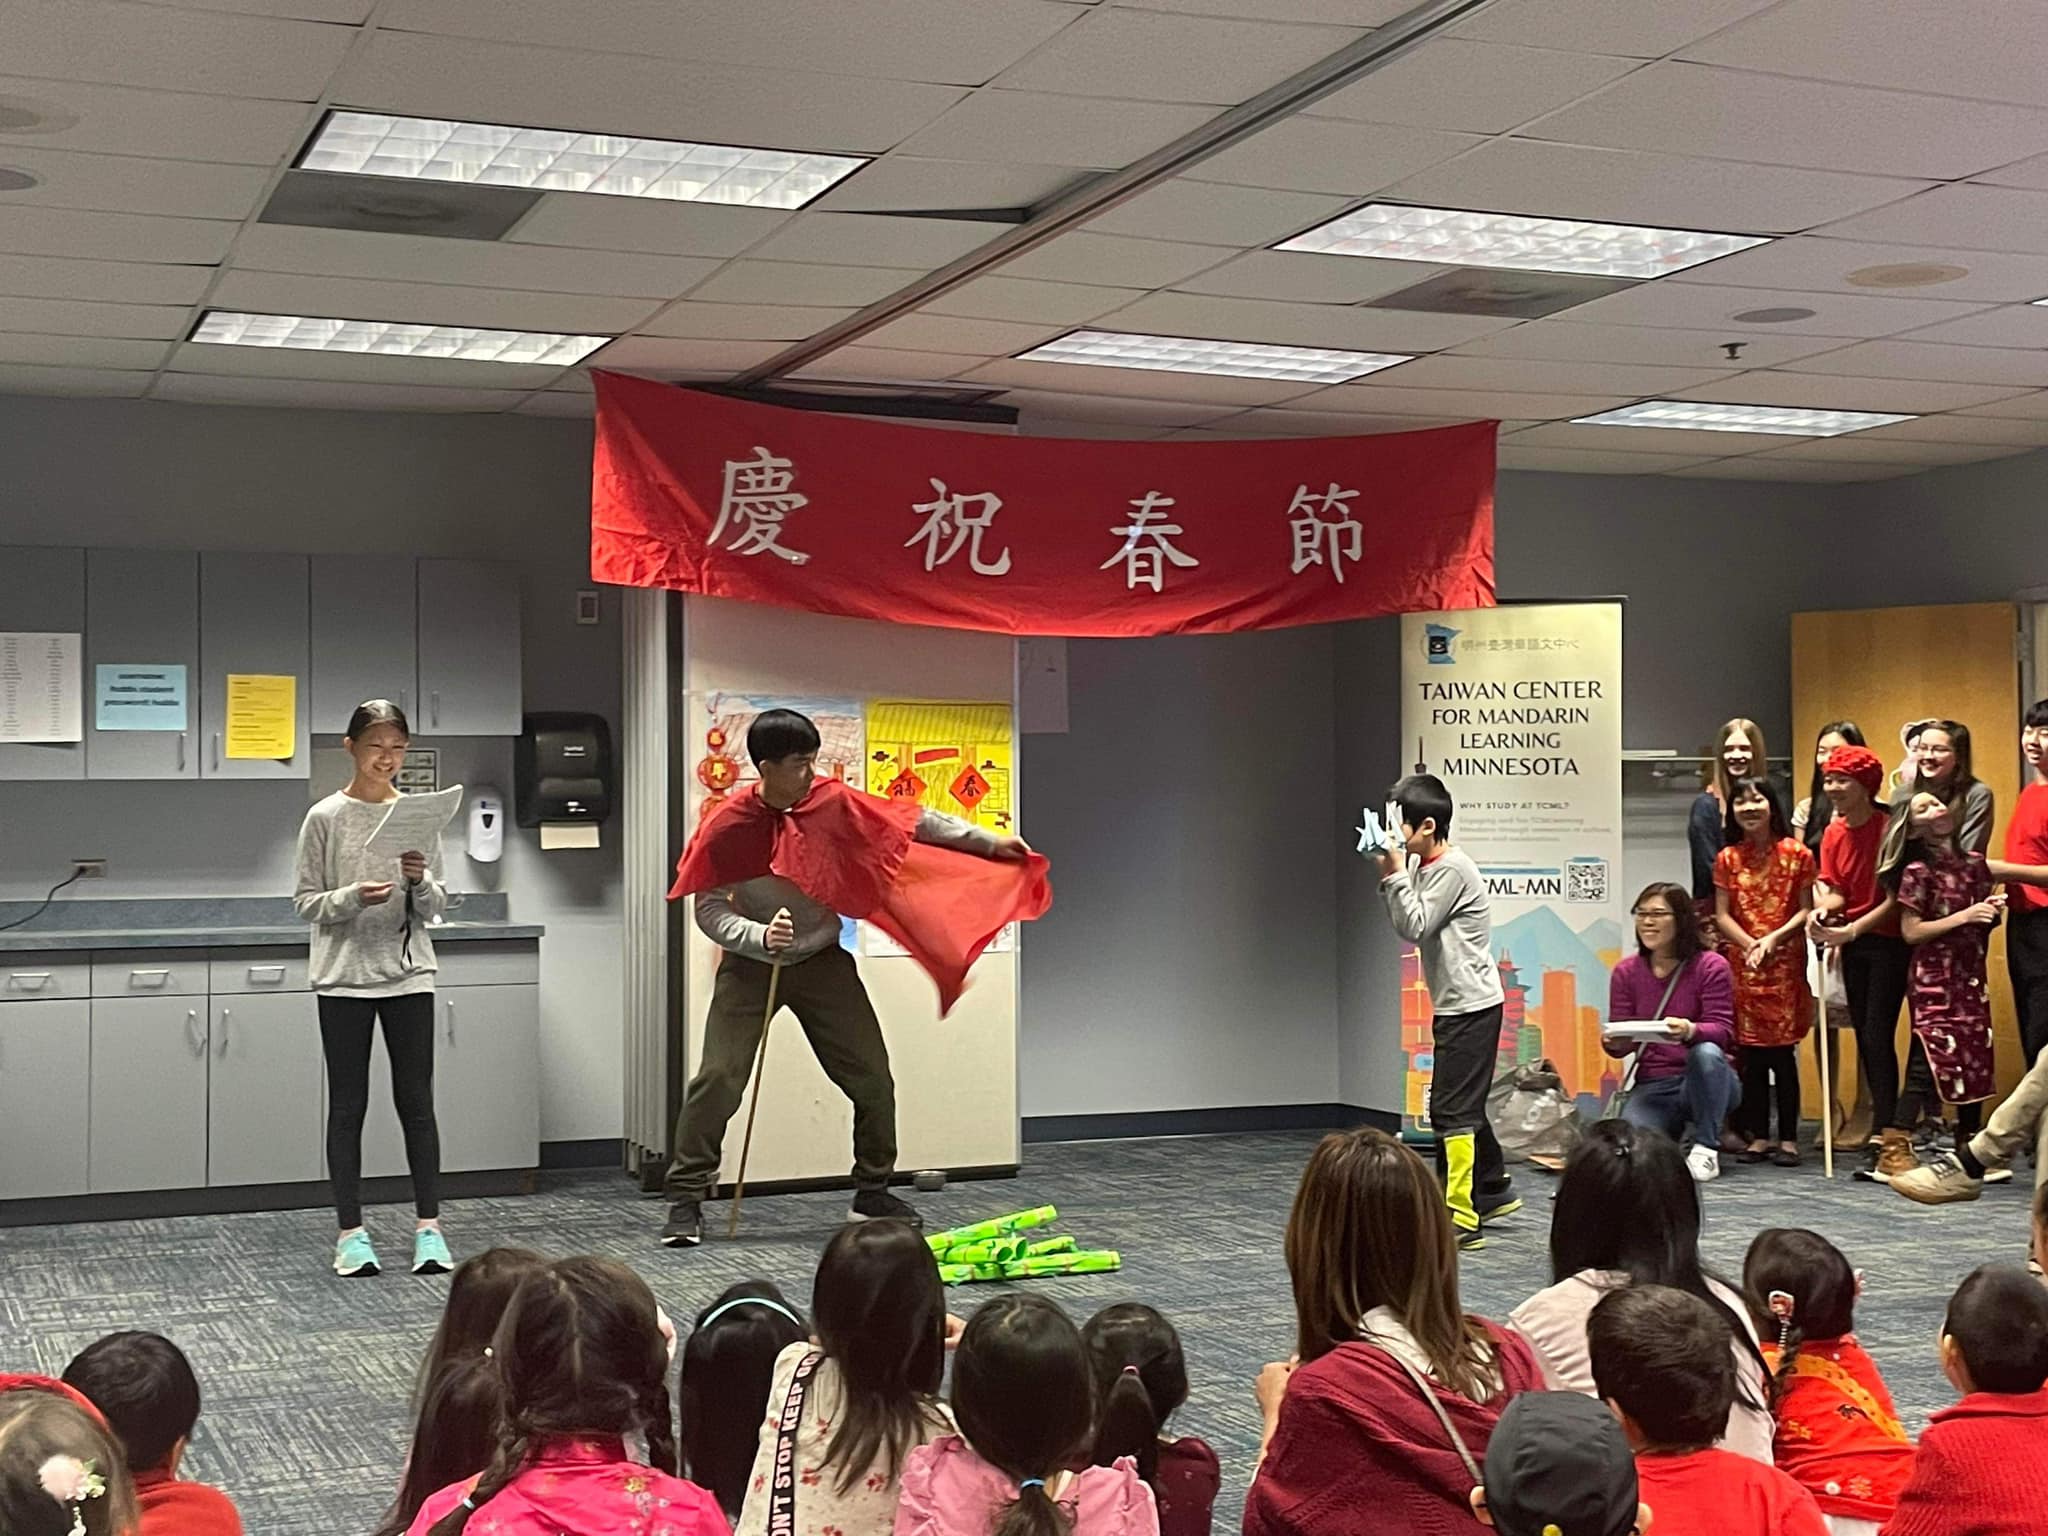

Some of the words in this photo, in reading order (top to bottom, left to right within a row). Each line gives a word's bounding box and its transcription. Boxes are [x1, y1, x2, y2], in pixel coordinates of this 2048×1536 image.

[706, 446, 1363, 593] 慶祝春節
[1418, 682, 1506, 701] TAIWAN
[1513, 680, 1603, 700] CENTER
[1432, 708, 1472, 726] FOR
[1478, 707, 1590, 725] MANDARIN
[1460, 732, 1561, 749] LEARNING
[1443, 757, 1580, 776] MINNESOTA
[960, 774, 980, 797] 春
[1459, 802, 1482, 810] WHY
[1486, 802, 1518, 810] STUDY
[1520, 802, 1533, 810] AT
[1483, 878, 1561, 895] ML-MN
[781, 1382, 804, 1432] KEEP
[775, 1436, 793, 1489] STOP
